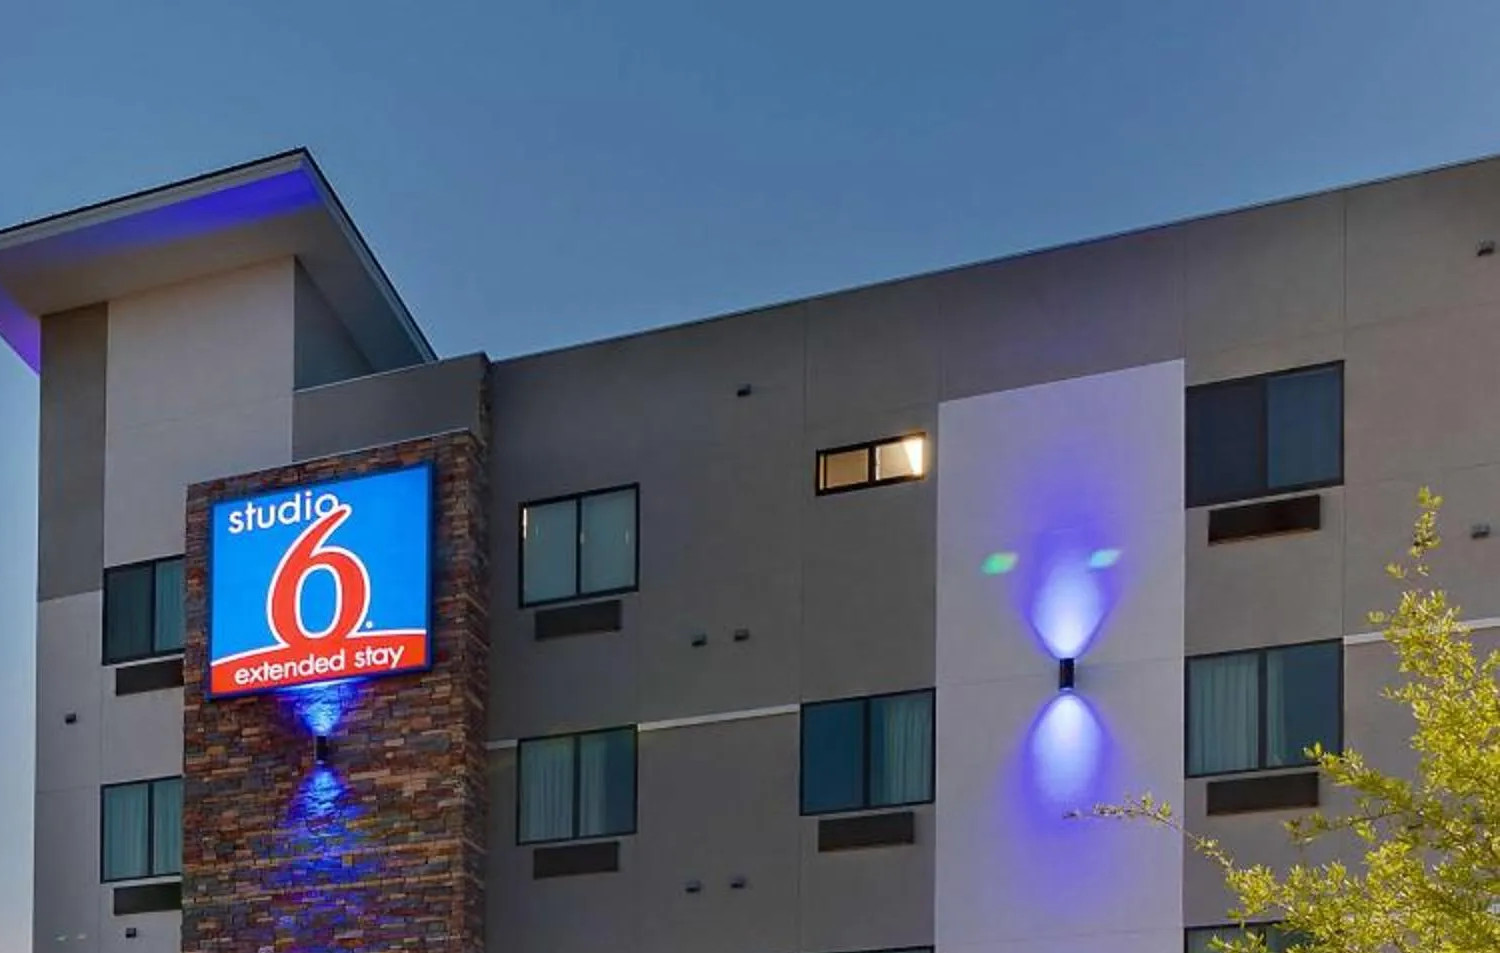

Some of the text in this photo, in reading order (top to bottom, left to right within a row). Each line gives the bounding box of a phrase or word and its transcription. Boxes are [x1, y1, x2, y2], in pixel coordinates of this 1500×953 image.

[228, 491, 339, 534] studio
[266, 503, 371, 645] 6
[234, 646, 405, 685] extended stay
